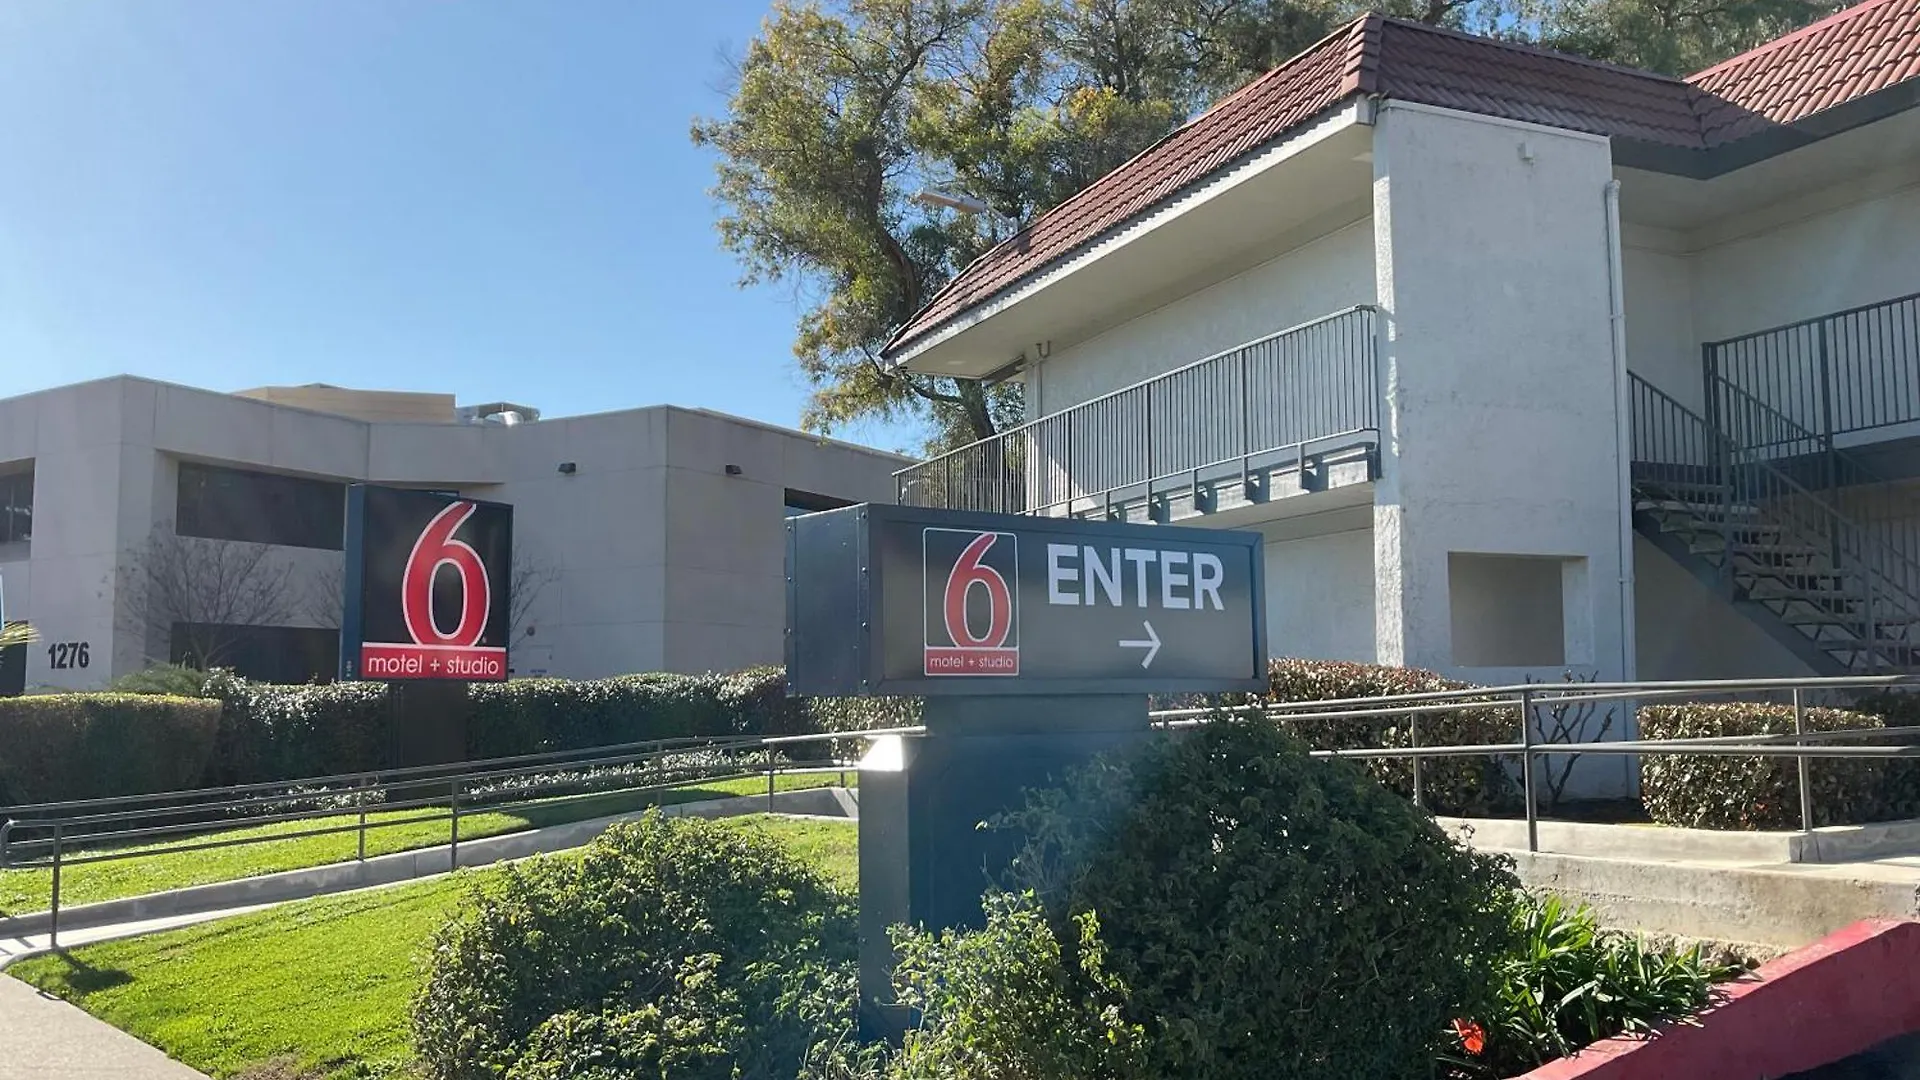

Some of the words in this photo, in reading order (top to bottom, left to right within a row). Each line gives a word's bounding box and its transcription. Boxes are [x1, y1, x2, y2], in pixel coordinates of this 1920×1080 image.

[402, 500, 491, 647] 6
[944, 532, 1012, 648] 6
[1047, 543, 1225, 610] ENTER
[48, 641, 90, 669] 1276
[368, 655, 423, 674] motel
[446, 655, 499, 675] studio
[929, 656, 964, 668] motel
[978, 656, 1014, 668] studio
